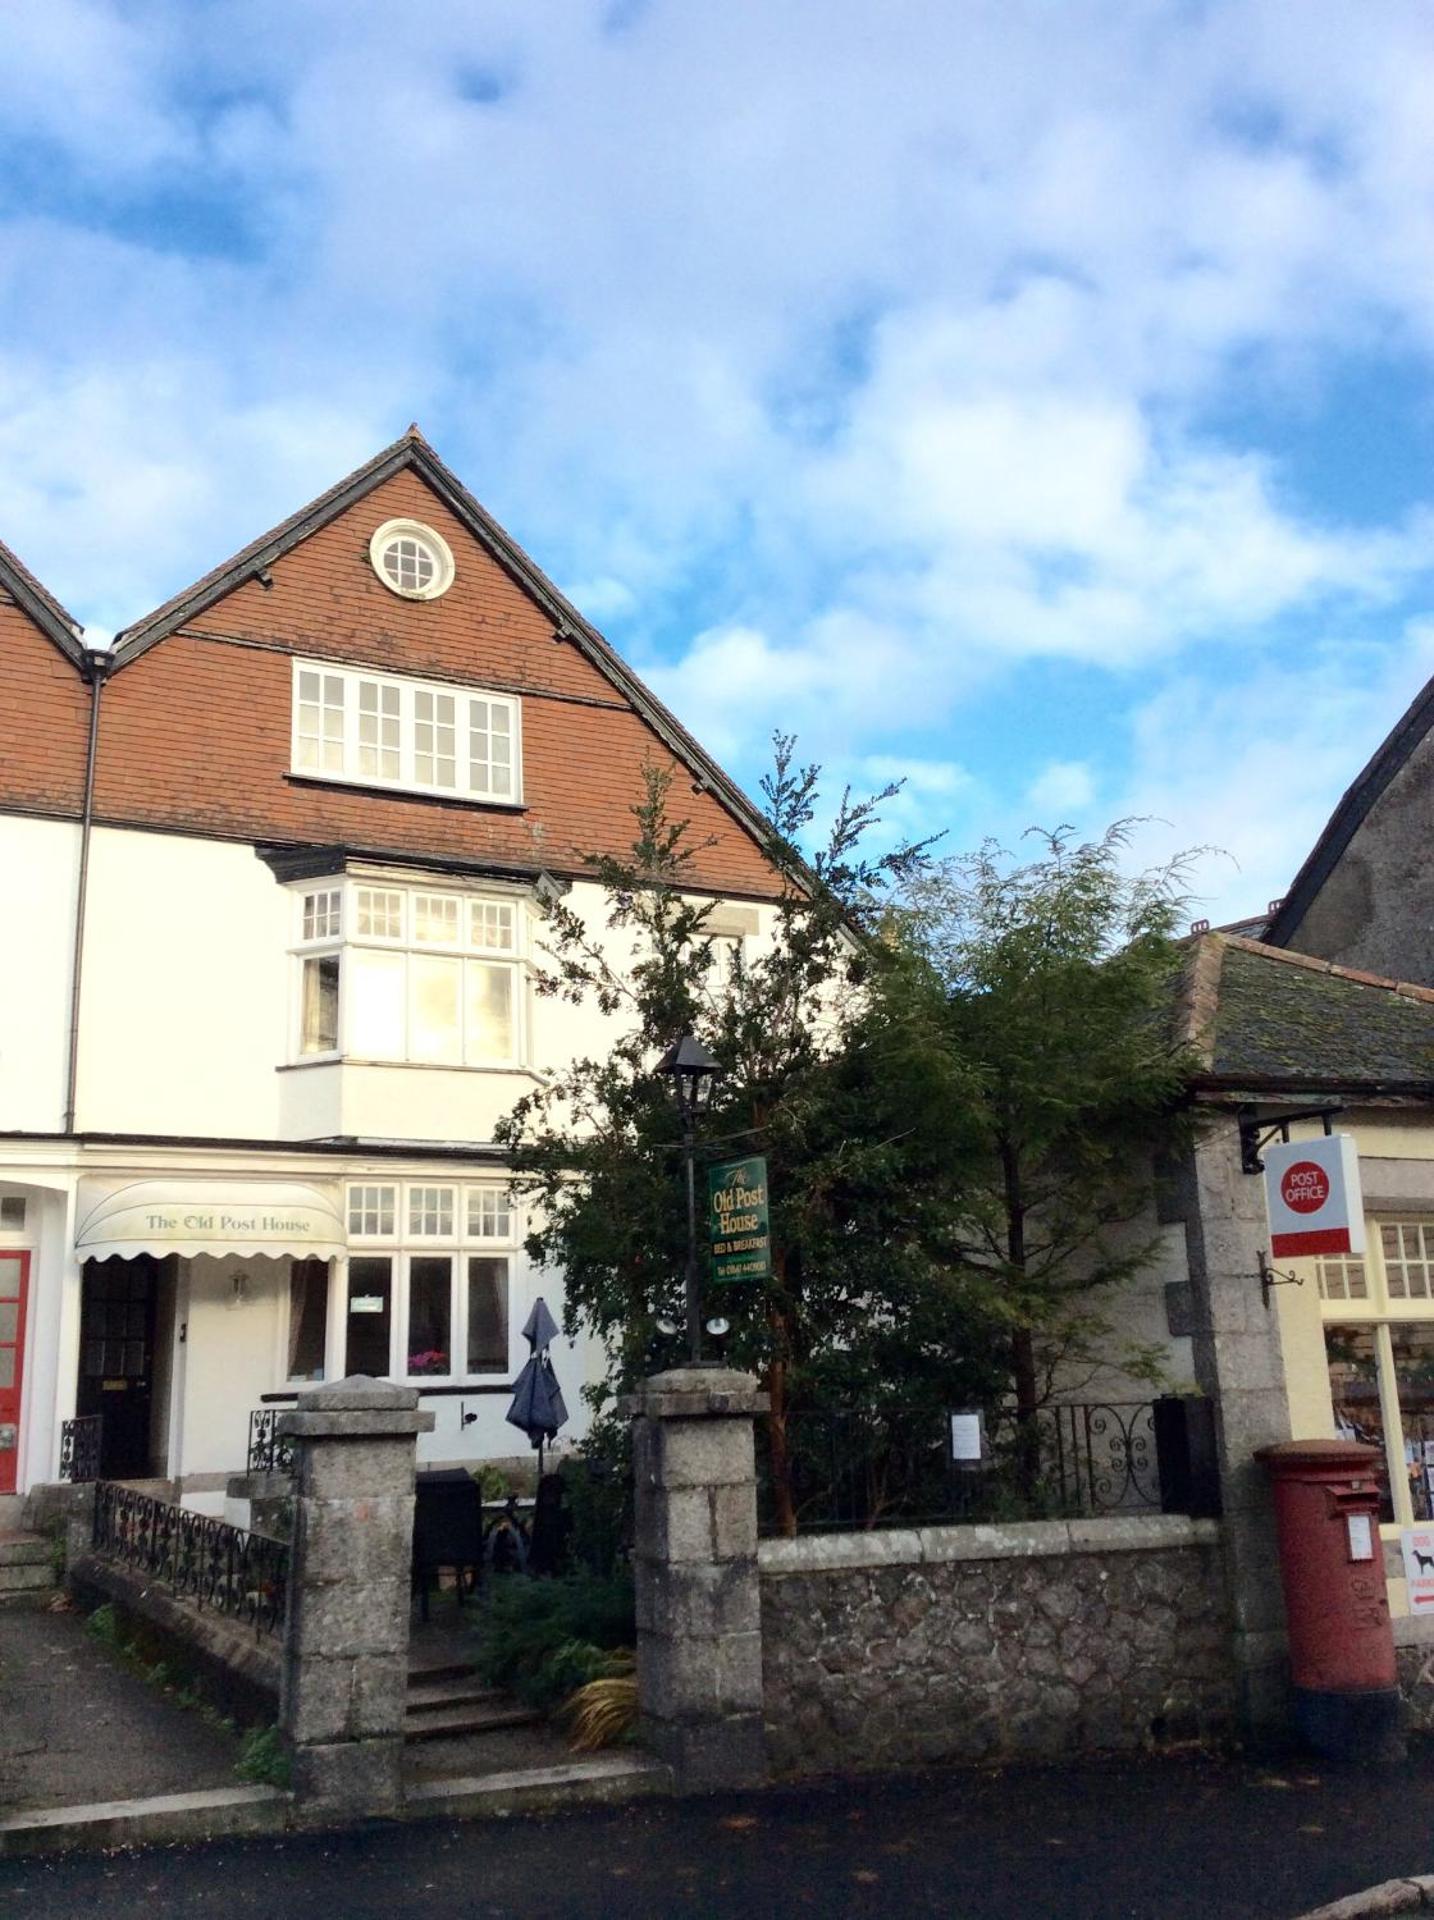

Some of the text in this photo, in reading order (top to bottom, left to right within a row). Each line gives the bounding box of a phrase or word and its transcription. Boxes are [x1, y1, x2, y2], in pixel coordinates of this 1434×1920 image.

[1291, 1171, 1320, 1187] POST
[714, 1184, 765, 1213] Old Post
[1285, 1185, 1325, 1202] OFFICE
[146, 1215, 310, 1232] The Old Post House
[720, 1212, 759, 1235] House
